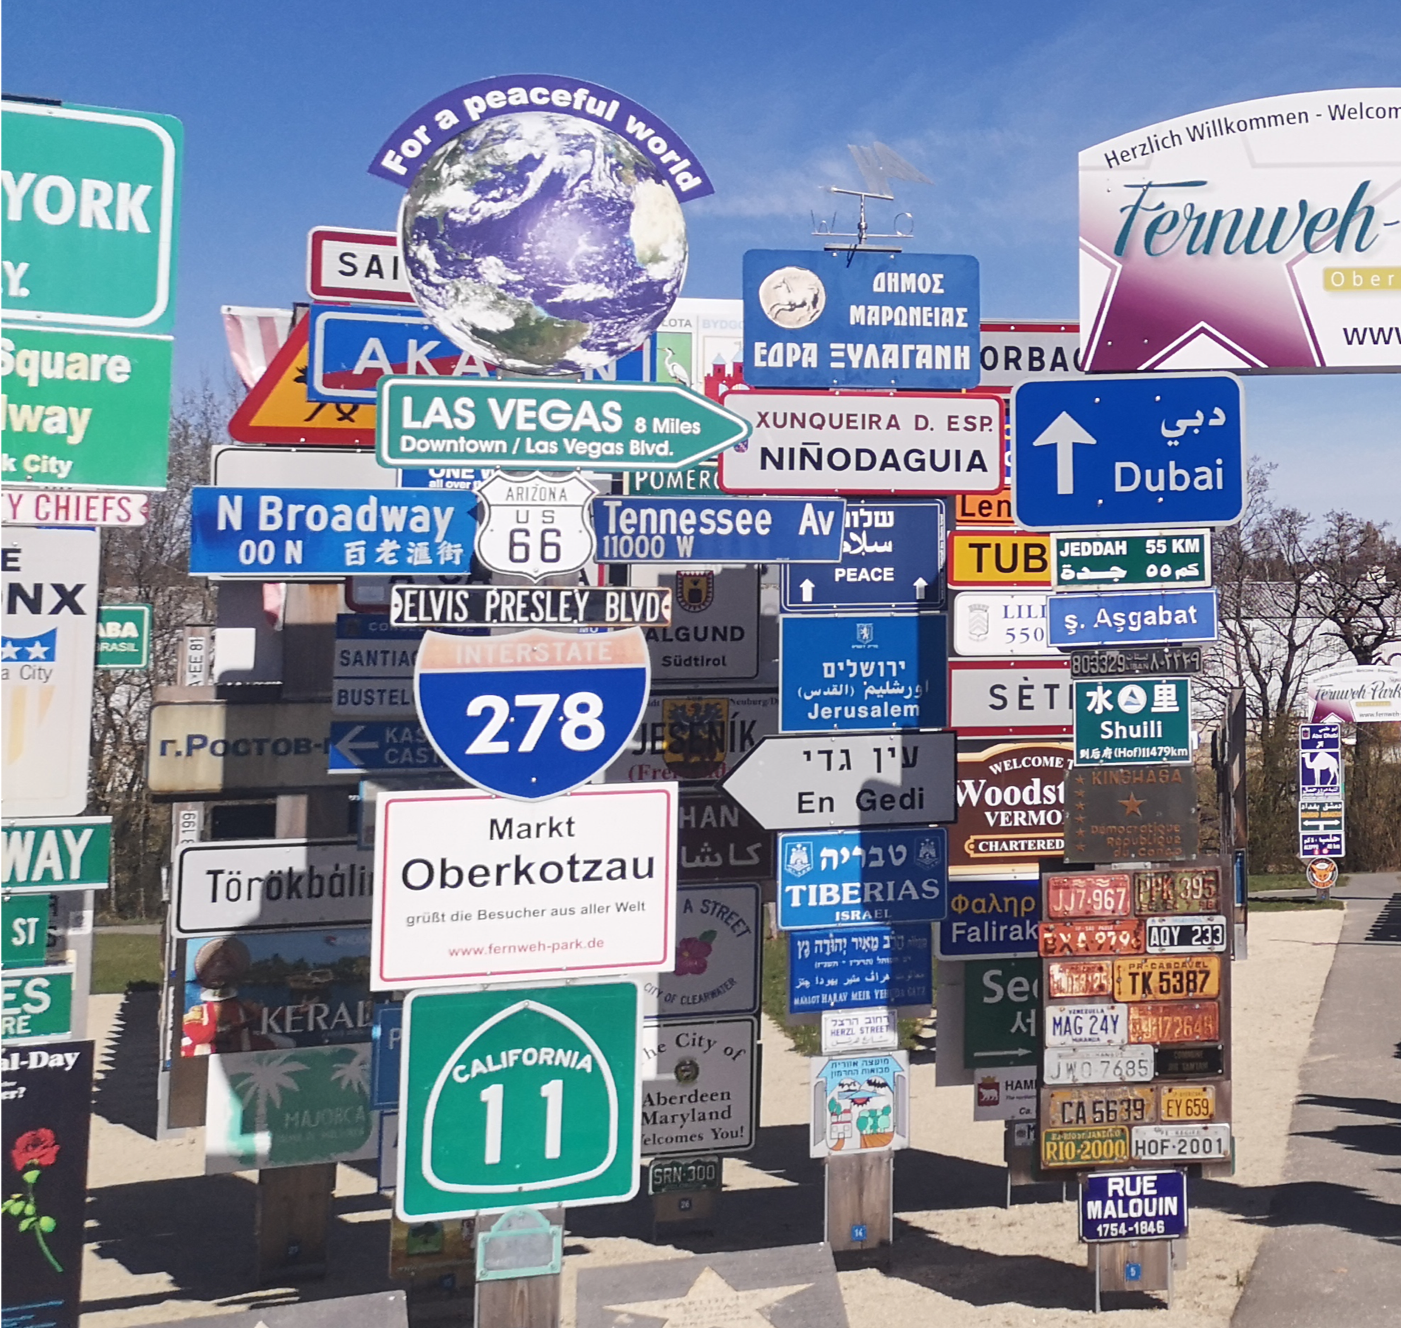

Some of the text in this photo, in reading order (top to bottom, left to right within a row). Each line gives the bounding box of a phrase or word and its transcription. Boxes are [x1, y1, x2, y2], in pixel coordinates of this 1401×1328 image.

[381, 86, 702, 192] For a peaceful world
[1104, 109, 1309, 168] Herzlich Willkommen
[1, 170, 154, 234] YORK
[873, 272, 945, 294] ΔΗΜΟΣ
[401, 396, 701, 434] LAS VEGAS 8 Miles
[756, 411, 993, 432] XUNQUEIRA D. ESP.
[1161, 407, 1226, 447] دبي
[400, 435, 674, 458] Downtown Las Vegas Blvd.
[760, 442, 988, 473] NIÑODAGUIA
[1115, 458, 1223, 492] Dubai
[505, 484, 568, 502] ARIZONA
[34, 494, 132, 523] CHIEFS
[217, 493, 454, 542] N Broadway
[603, 500, 835, 535] Tennessee Av
[603, 535, 694, 558] 11000 W
[1060, 538, 1200, 557] JEDDAH 55 KM
[835, 568, 895, 582] PEACE
[403, 590, 661, 623] ELVIS PRESLEY BLVD
[1093, 605, 1198, 632] Aşgabat
[456, 641, 613, 665] INTERSTATE
[661, 656, 726, 667] Südtirol
[465, 691, 606, 755] 278
[808, 703, 920, 720] Jerusalem
[1100, 720, 1163, 740] Shuili
[797, 787, 924, 814] En Gedi
[489, 816, 576, 840] Markt
[402, 853, 654, 891] Oberkotzau
[786, 878, 940, 908] TIBERIAS
[406, 901, 646, 927] grüßt die Besucher aus aller Welt
[836, 908, 892, 922] ISRAEL
[448, 937, 605, 957] www.fernweh-park.de
[831, 1025, 890, 1036] HERZL STREET
[452, 1047, 594, 1084] CALIFORNIA
[1108, 1176, 1157, 1197] RUE
[1087, 1197, 1178, 1220] MALOUIN
[1097, 1221, 1165, 1237] 1754-1846
